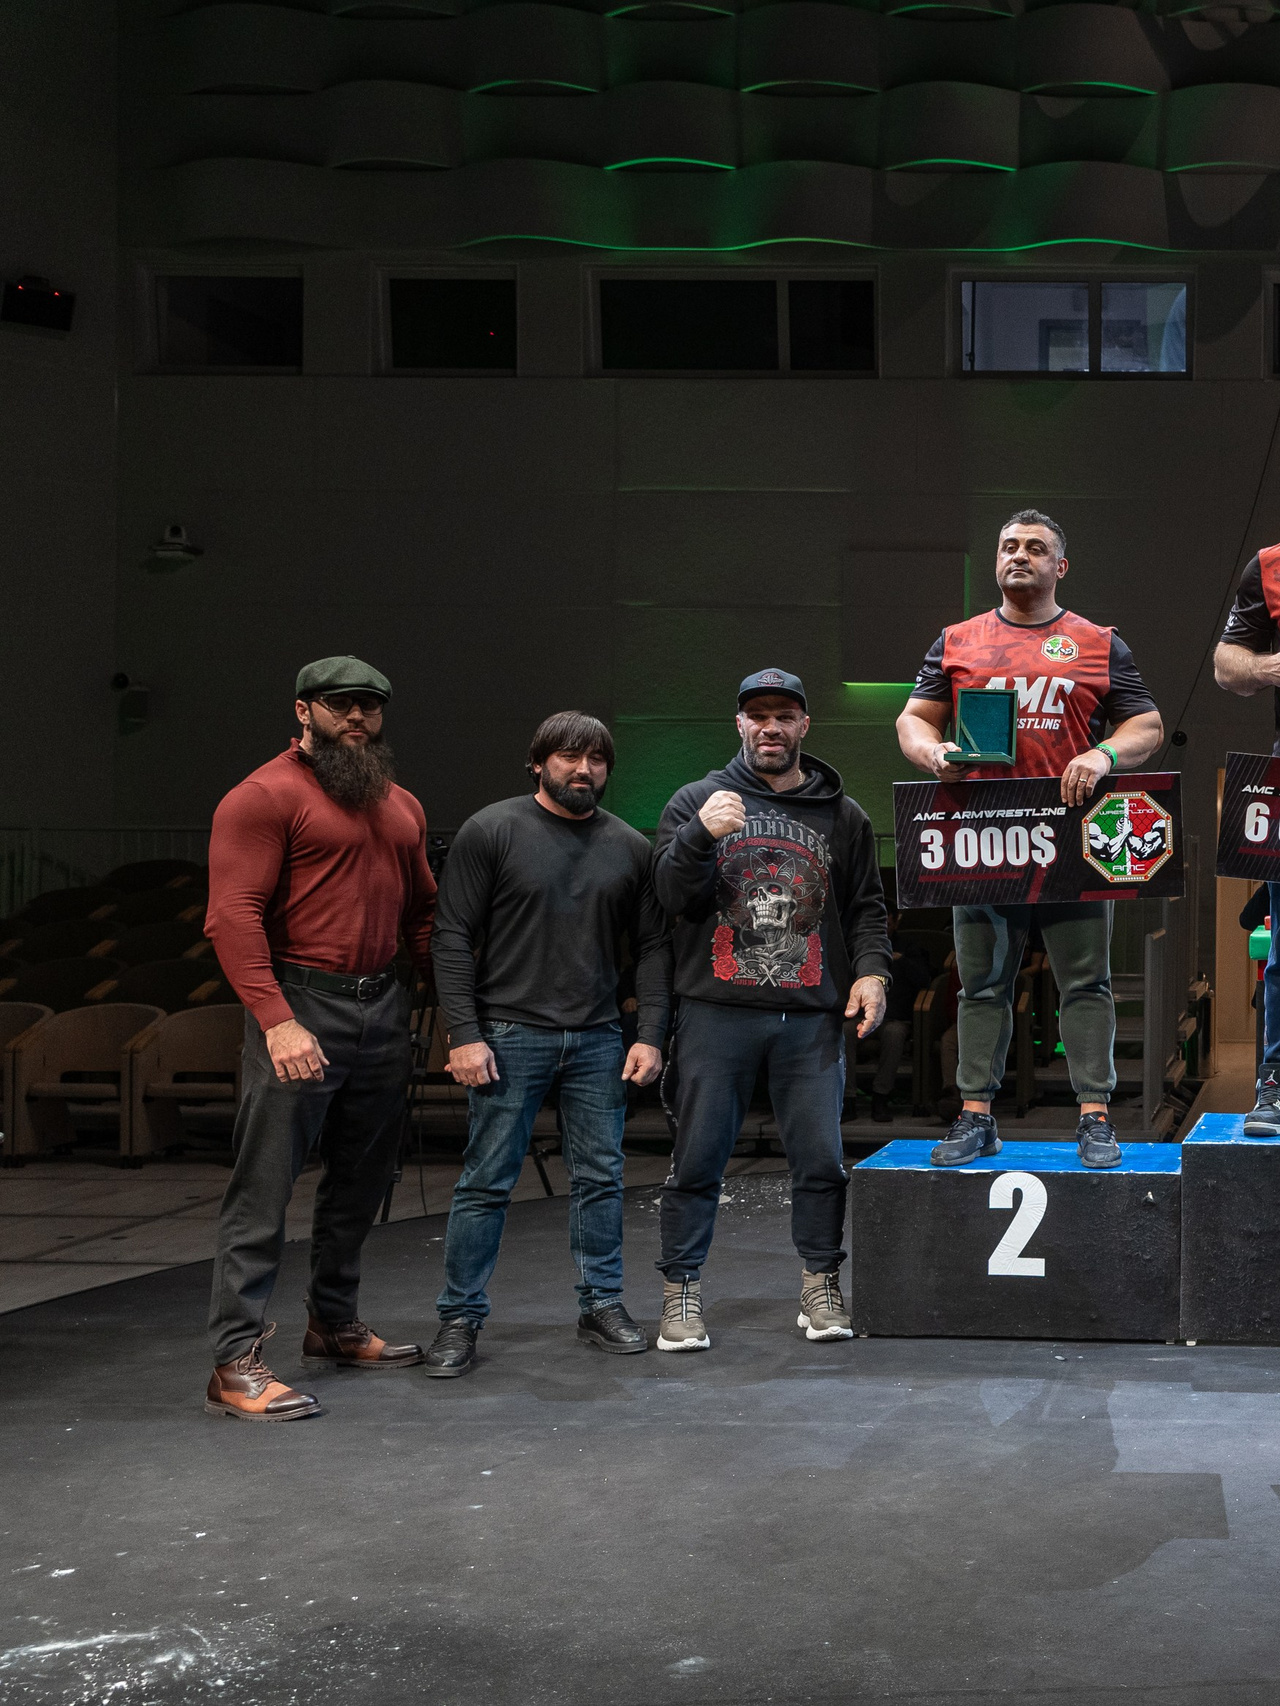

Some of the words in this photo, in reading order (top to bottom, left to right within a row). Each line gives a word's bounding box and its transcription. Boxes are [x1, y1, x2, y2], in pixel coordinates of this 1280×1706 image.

[1242, 784, 1275, 795] AMC
[913, 812, 946, 822] AMC
[951, 807, 1067, 820] ARMWRESTLING
[988, 1171, 1048, 1277] 2
